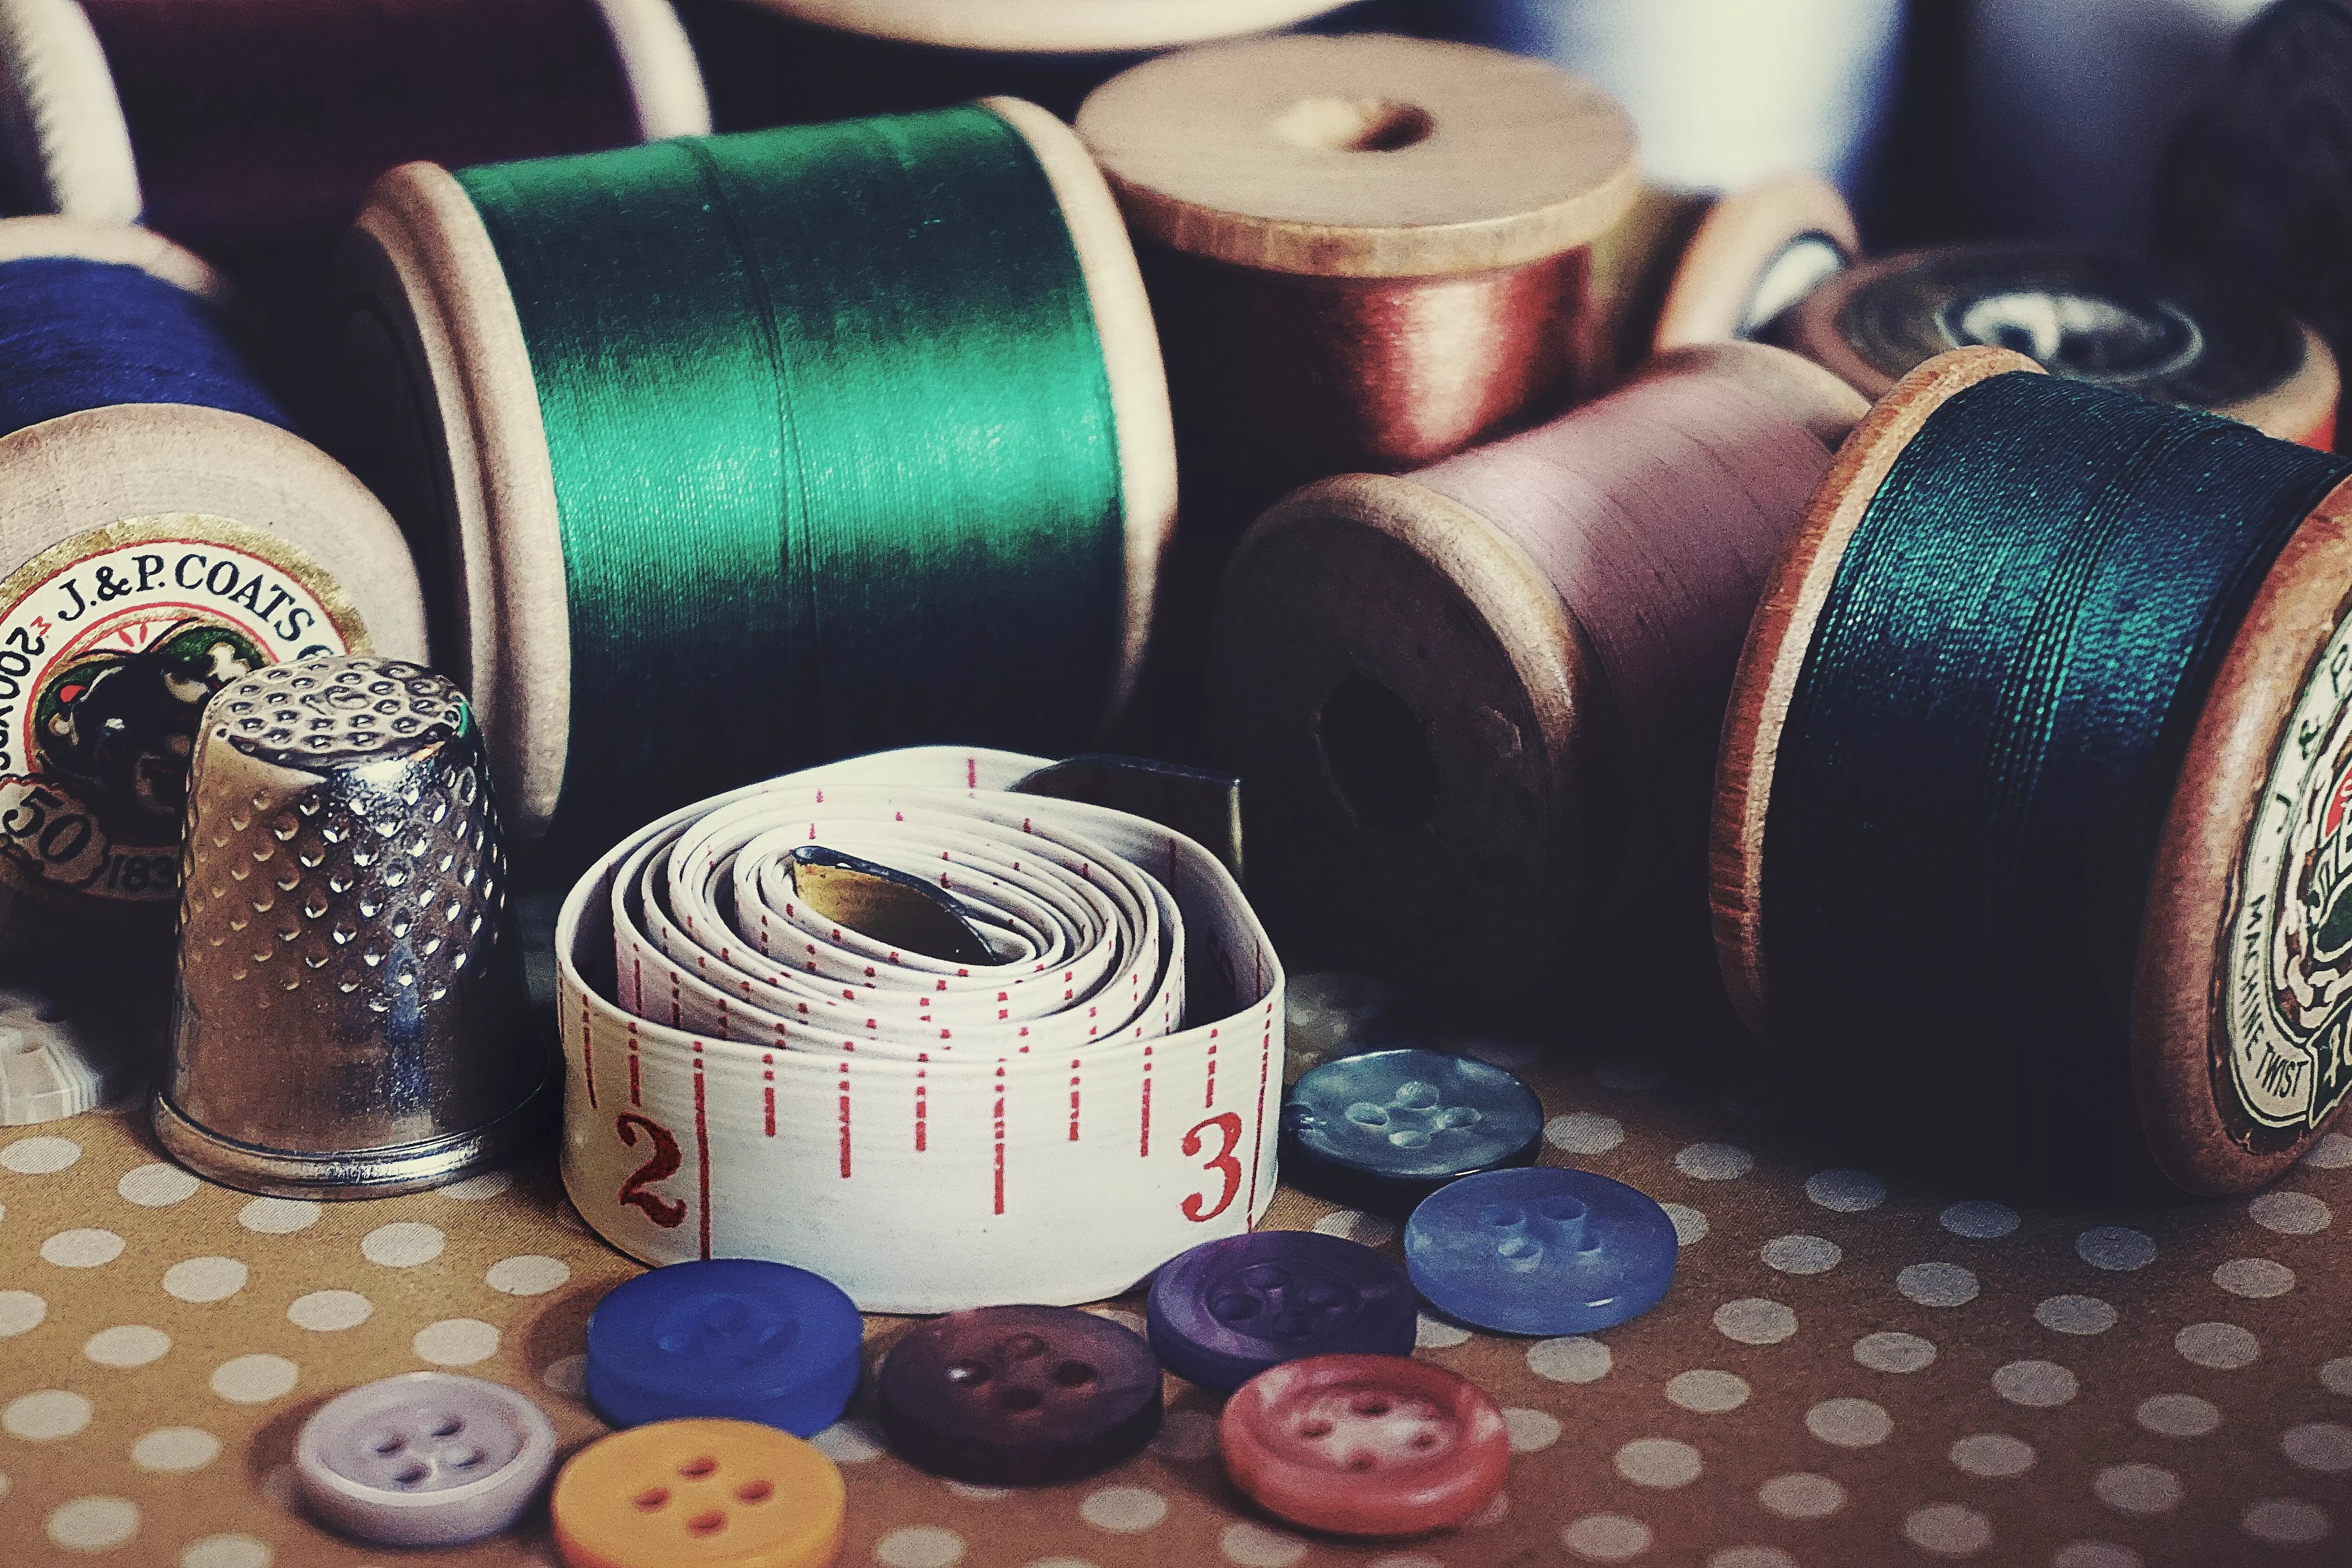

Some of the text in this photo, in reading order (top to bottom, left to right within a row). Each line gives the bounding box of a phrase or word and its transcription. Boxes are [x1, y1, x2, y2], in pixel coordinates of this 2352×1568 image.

[175, 553, 315, 642] COATS
[3, 786, 91, 864] 50
[2241, 895, 2308, 1098] MACHINE TWIST
[615, 1112, 687, 1230] 2
[1181, 1111, 1242, 1223] 3
